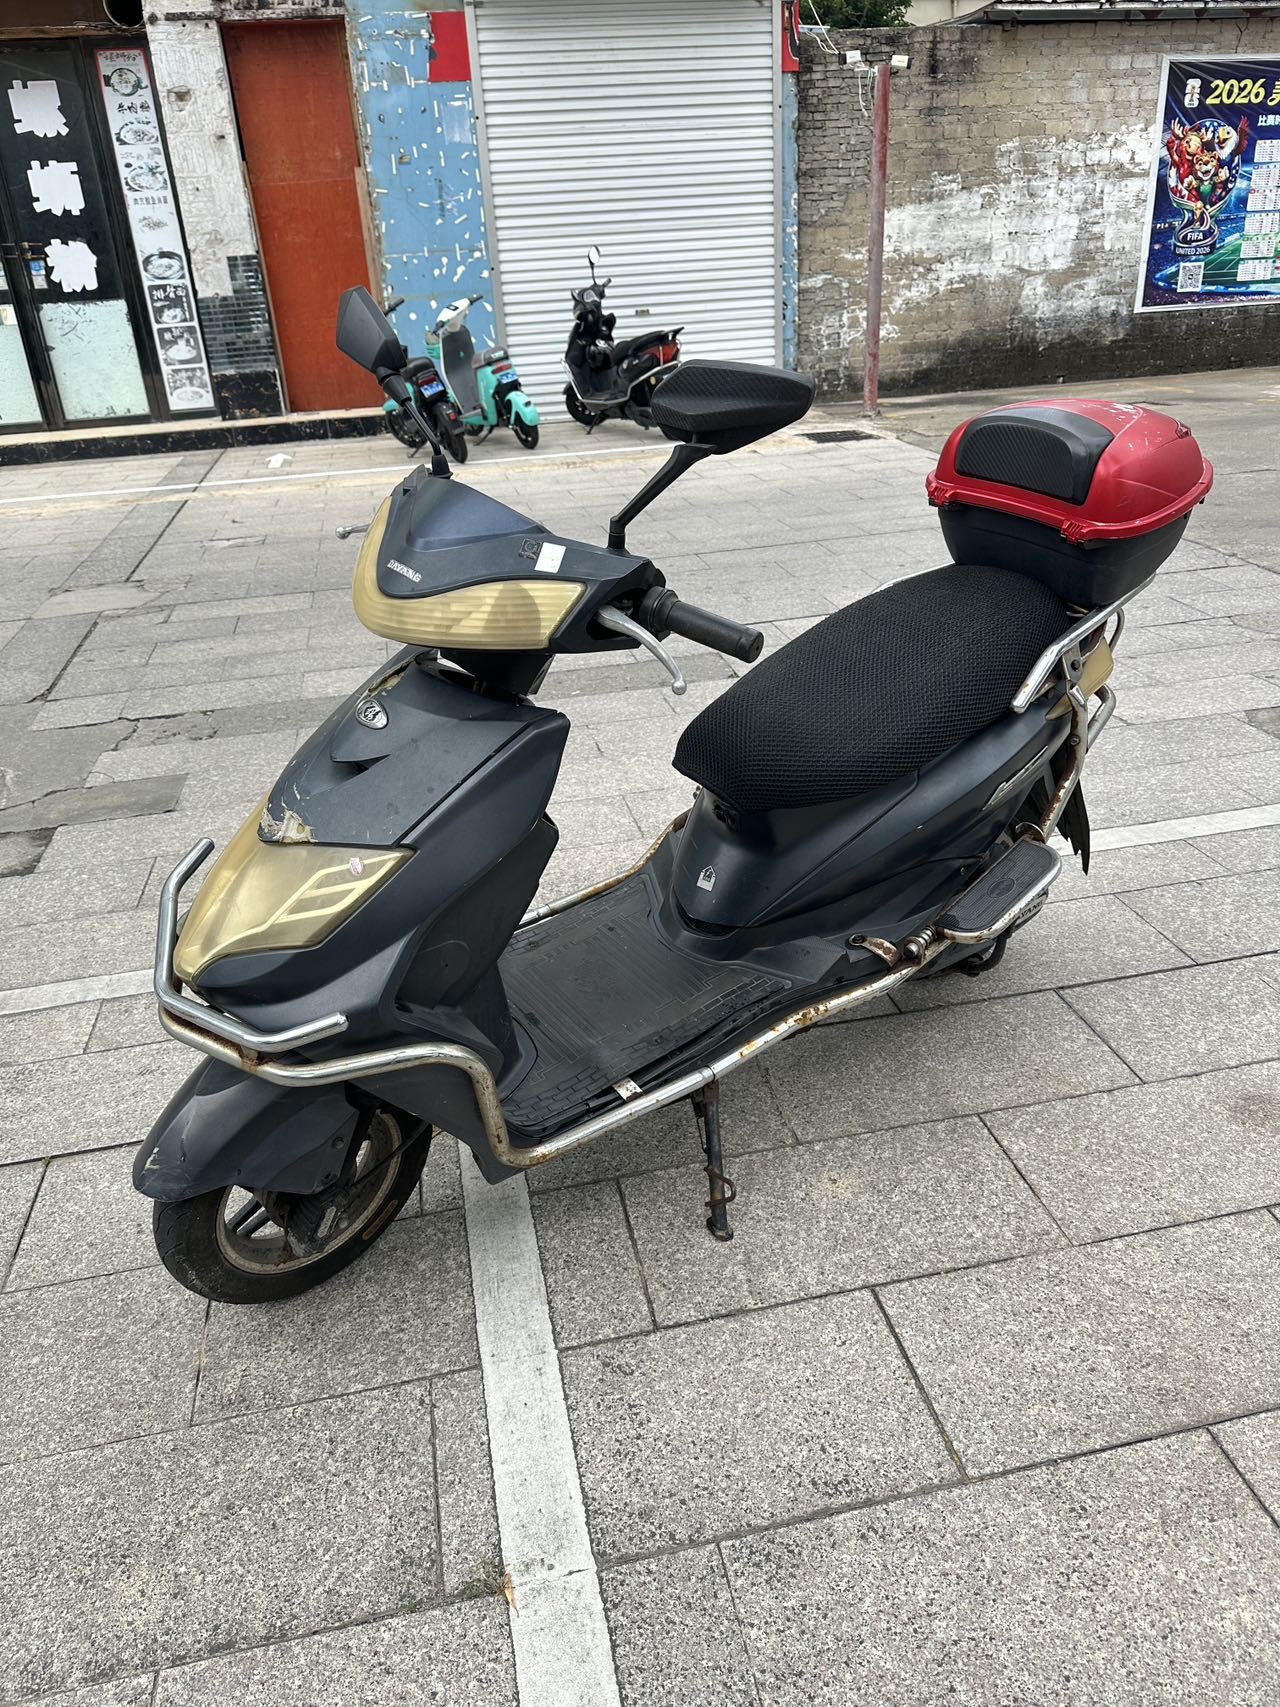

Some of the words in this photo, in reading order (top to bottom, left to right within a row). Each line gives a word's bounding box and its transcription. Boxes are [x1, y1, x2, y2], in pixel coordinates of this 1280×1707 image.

[1206, 78, 1266, 105] 2026
[1187, 232, 1204, 241] FIFA
[1175, 247, 1196, 255] UNITED
[1196, 246, 1211, 255] 2026
[387, 559, 422, 583] DAYANG
